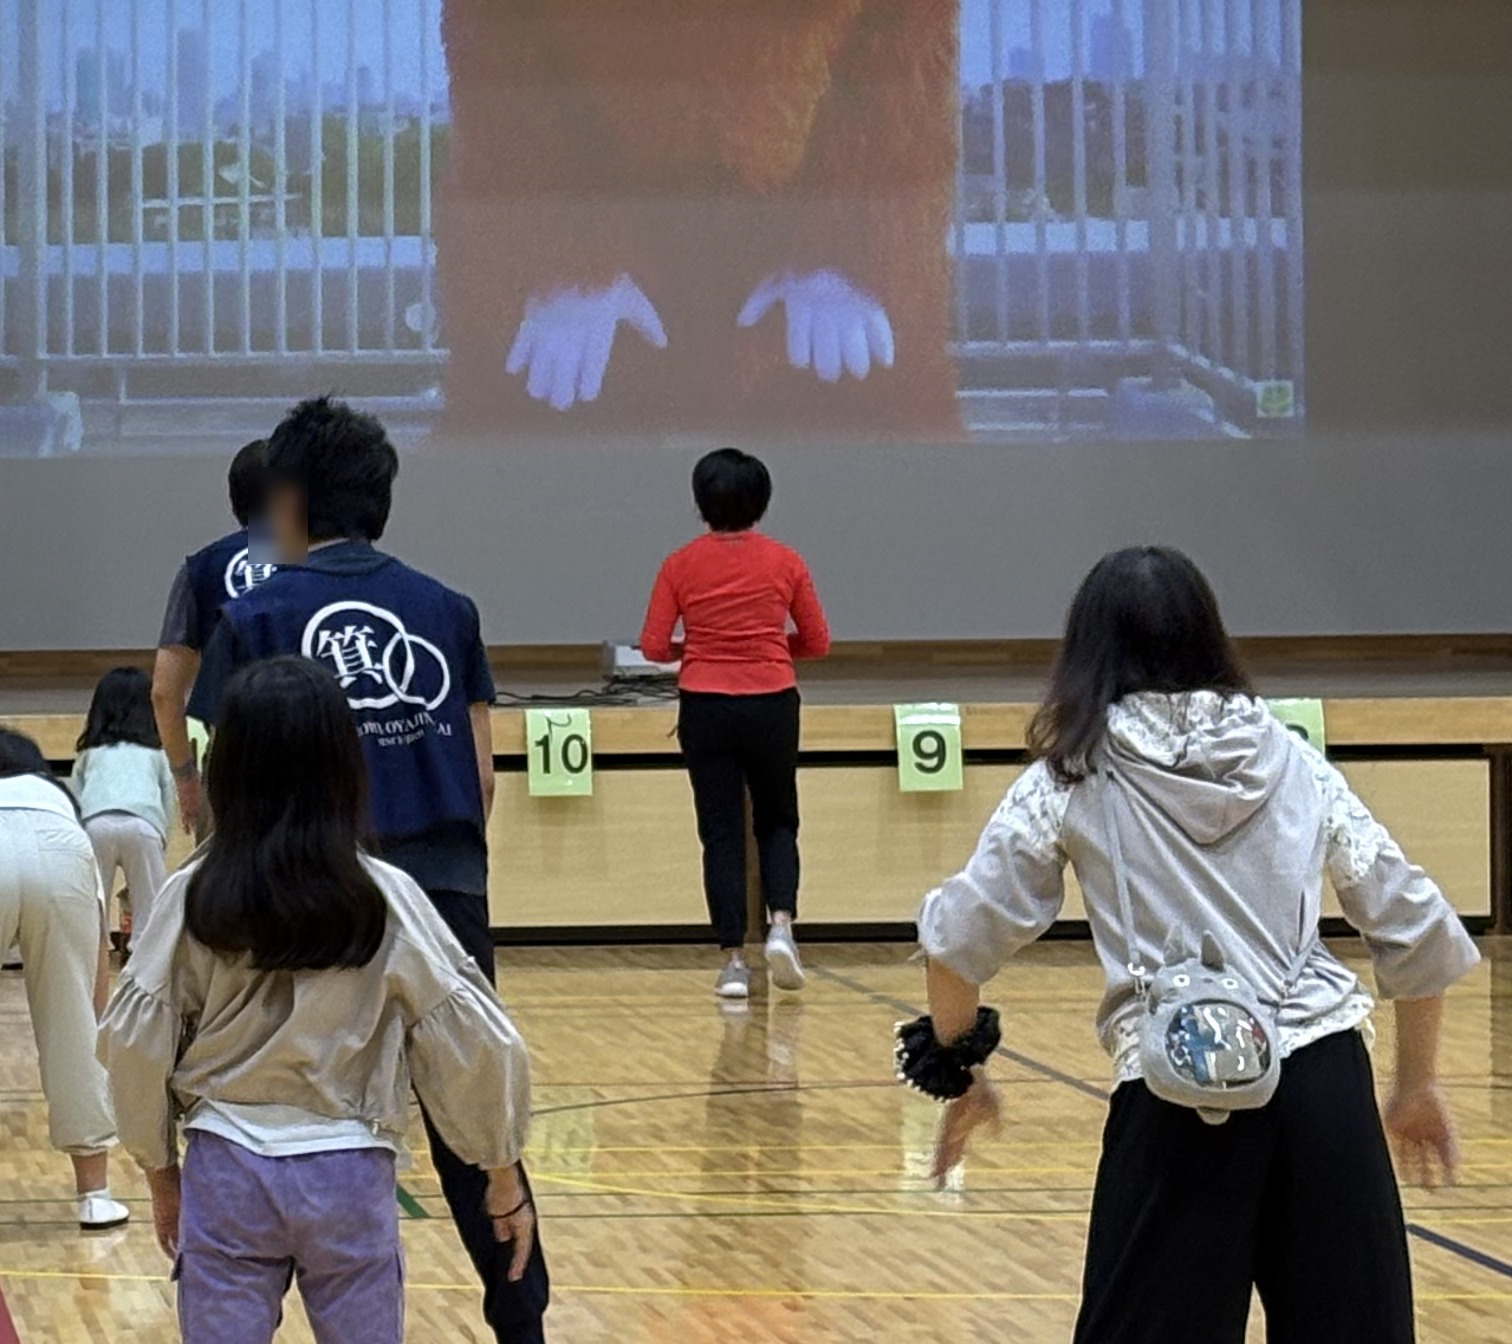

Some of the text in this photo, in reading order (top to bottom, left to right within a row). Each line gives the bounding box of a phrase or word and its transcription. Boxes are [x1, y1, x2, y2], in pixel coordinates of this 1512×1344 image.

[316, 625, 384, 689] 箕
[534, 733, 588, 775] 10
[912, 729, 946, 774] 9
